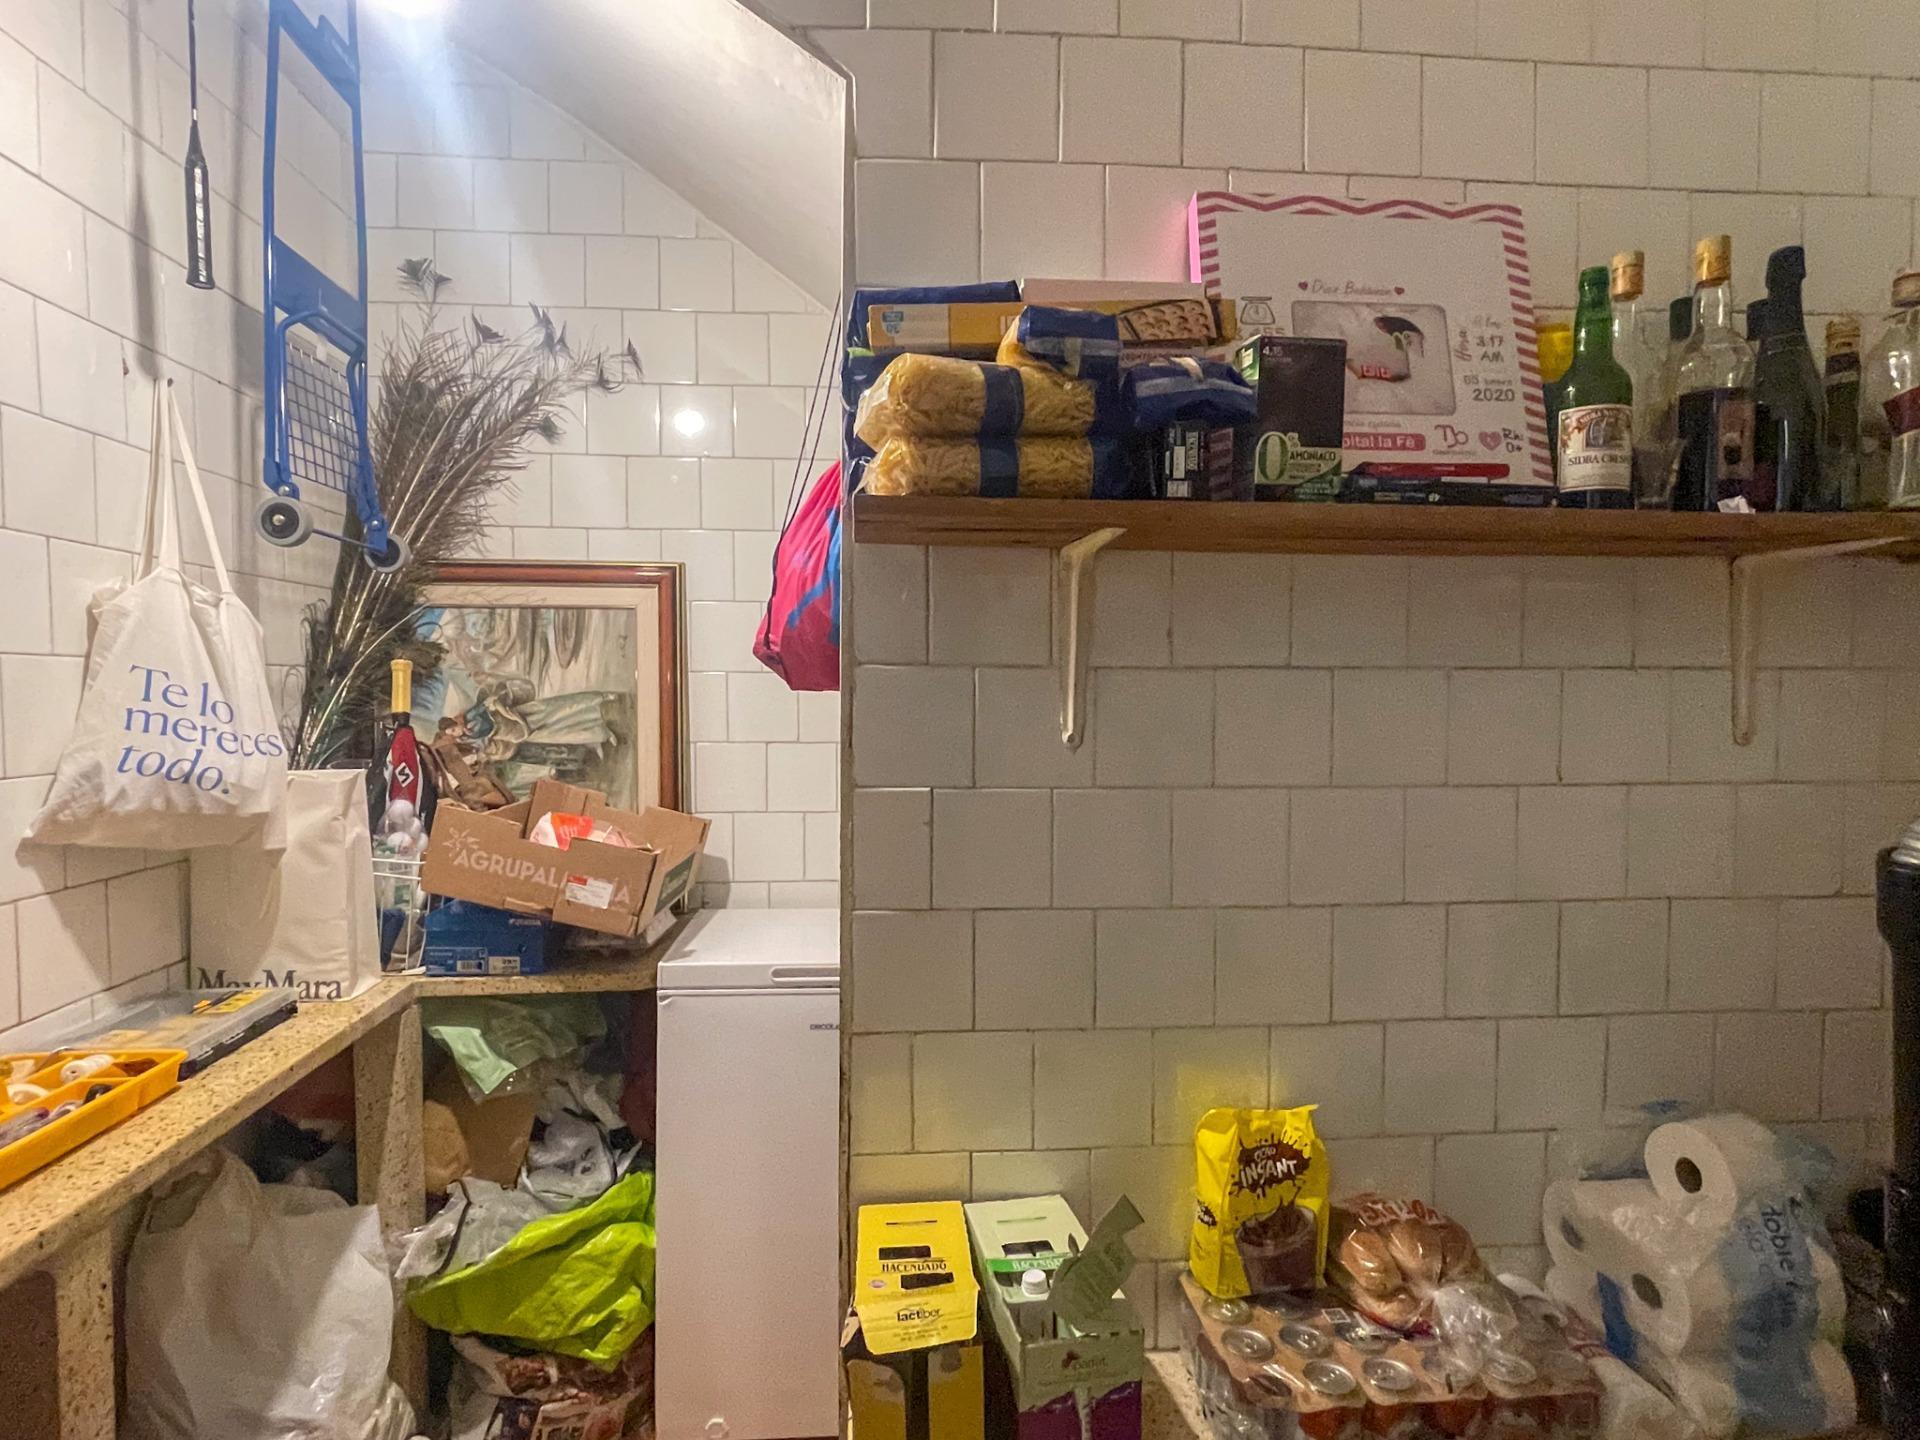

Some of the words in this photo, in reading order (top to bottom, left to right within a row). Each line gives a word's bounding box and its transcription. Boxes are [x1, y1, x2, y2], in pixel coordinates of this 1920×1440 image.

[1473, 388, 1515, 401] 2020
[1378, 435, 1392, 448] la
[129, 663, 189, 709] Te
[199, 682, 234, 725] lo
[124, 707, 283, 757] mereces
[116, 745, 230, 795] todo.
[882, 1261, 947, 1273] HACENDADO
